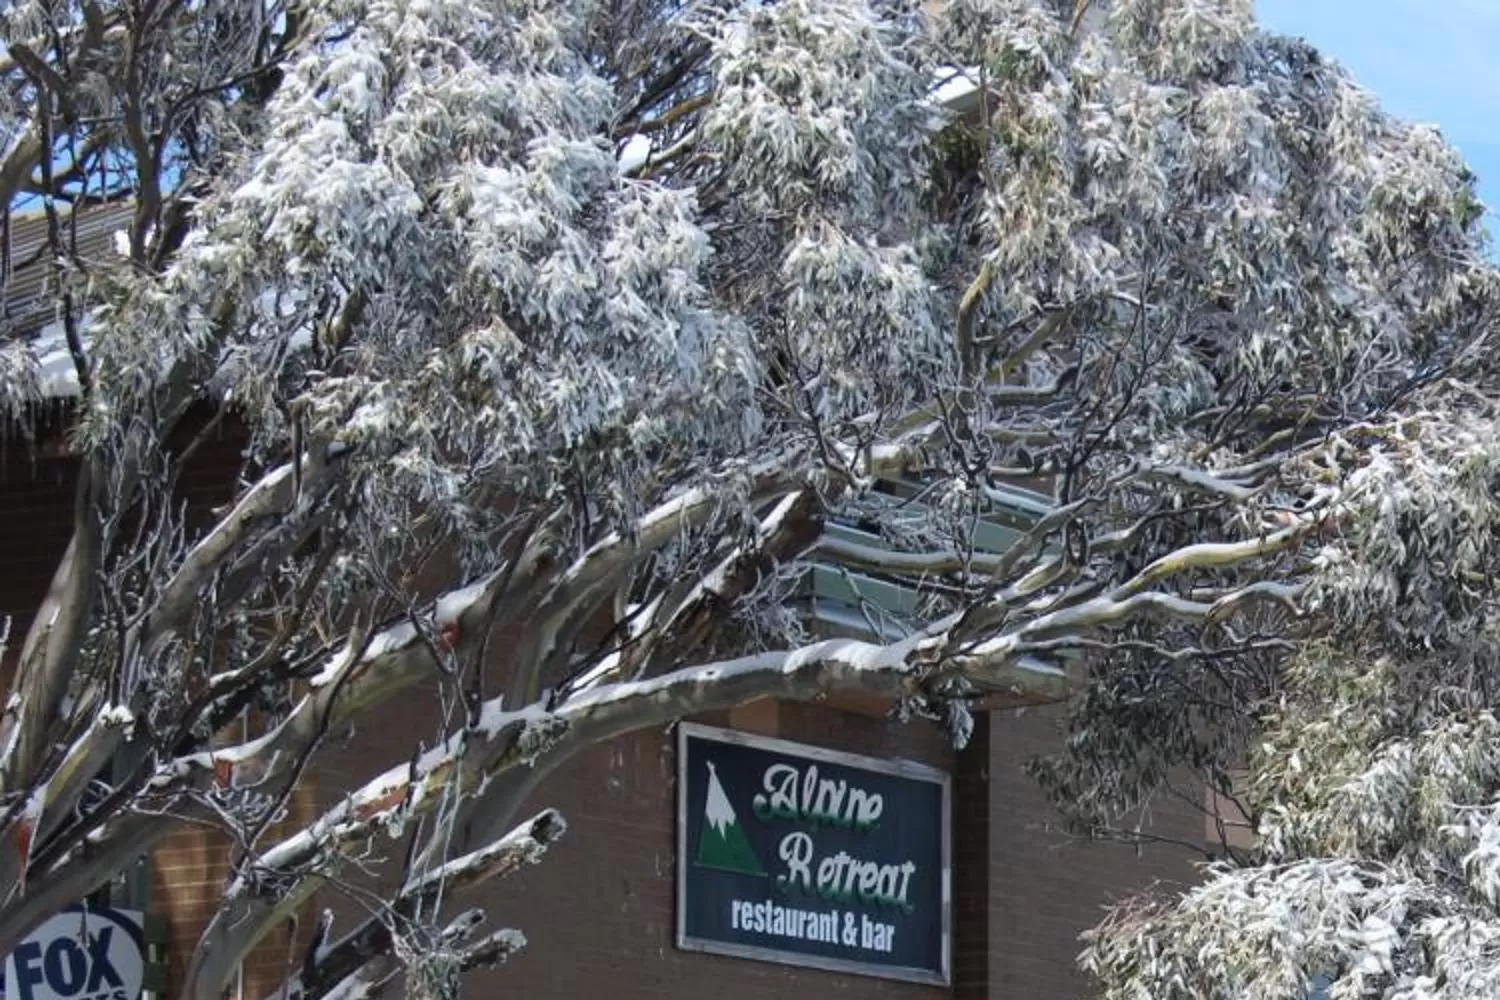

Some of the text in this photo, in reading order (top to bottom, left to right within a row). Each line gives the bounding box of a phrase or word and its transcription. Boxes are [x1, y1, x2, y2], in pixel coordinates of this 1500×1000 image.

[752, 763, 883, 832] Alpine
[774, 831, 916, 911] Retreat
[731, 900, 896, 952] restaurant & bar
